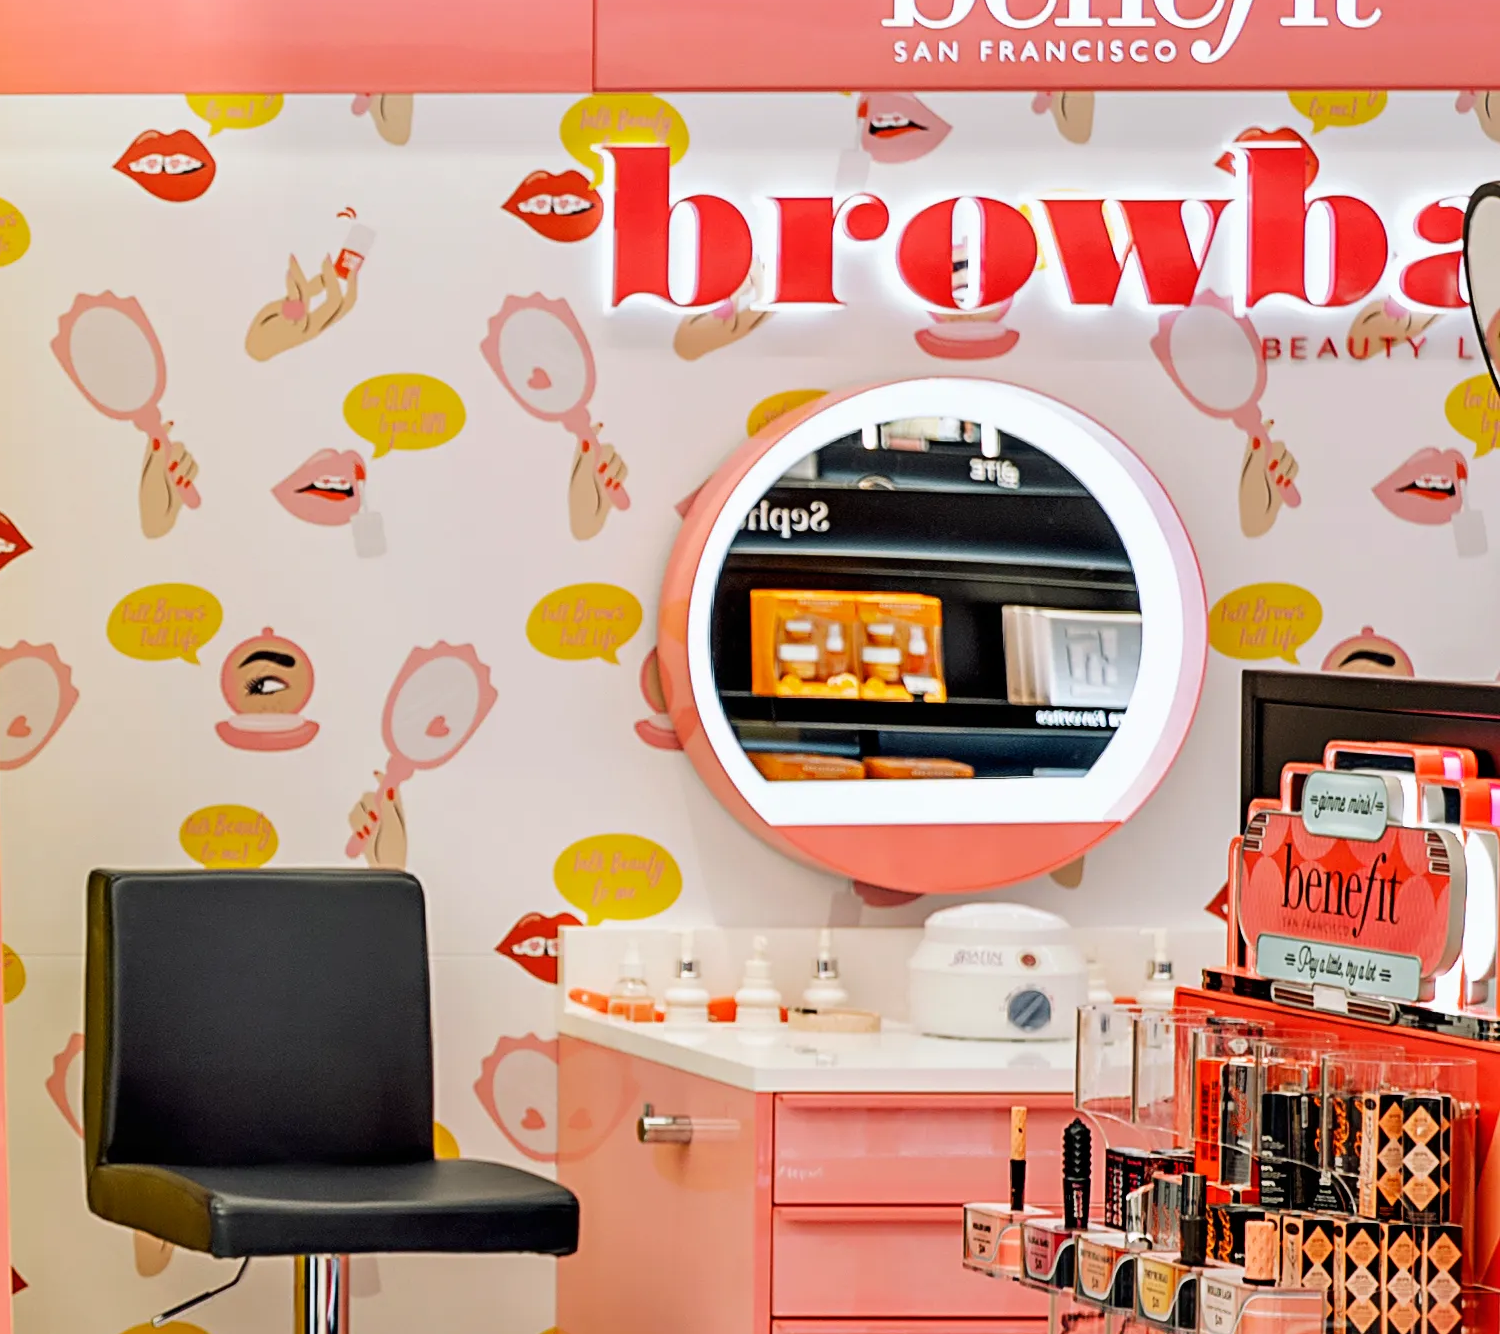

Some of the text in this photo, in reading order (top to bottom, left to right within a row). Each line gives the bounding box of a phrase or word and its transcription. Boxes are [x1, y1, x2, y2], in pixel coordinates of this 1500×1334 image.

[893, 40, 1177, 63] SAN FRANCISCO
[594, 141, 1470, 315] browba
[1262, 337, 1427, 361] BEAUTY
[153, 598, 207, 623] Brows
[572, 598, 626, 623] Brows
[1252, 596, 1306, 621] Brows
[1314, 791, 1377, 818] gimme minis!
[213, 812, 272, 849] Beauty
[610, 849, 667, 888] Beauty
[1281, 842, 1403, 939] benefit
[1300, 919, 1349, 937] FRANCISCO
[1298, 944, 1317, 980] Pay
[1325, 953, 1344, 978] little,
[1346, 959, 1357, 986] try
[1365, 962, 1376, 982] lot
